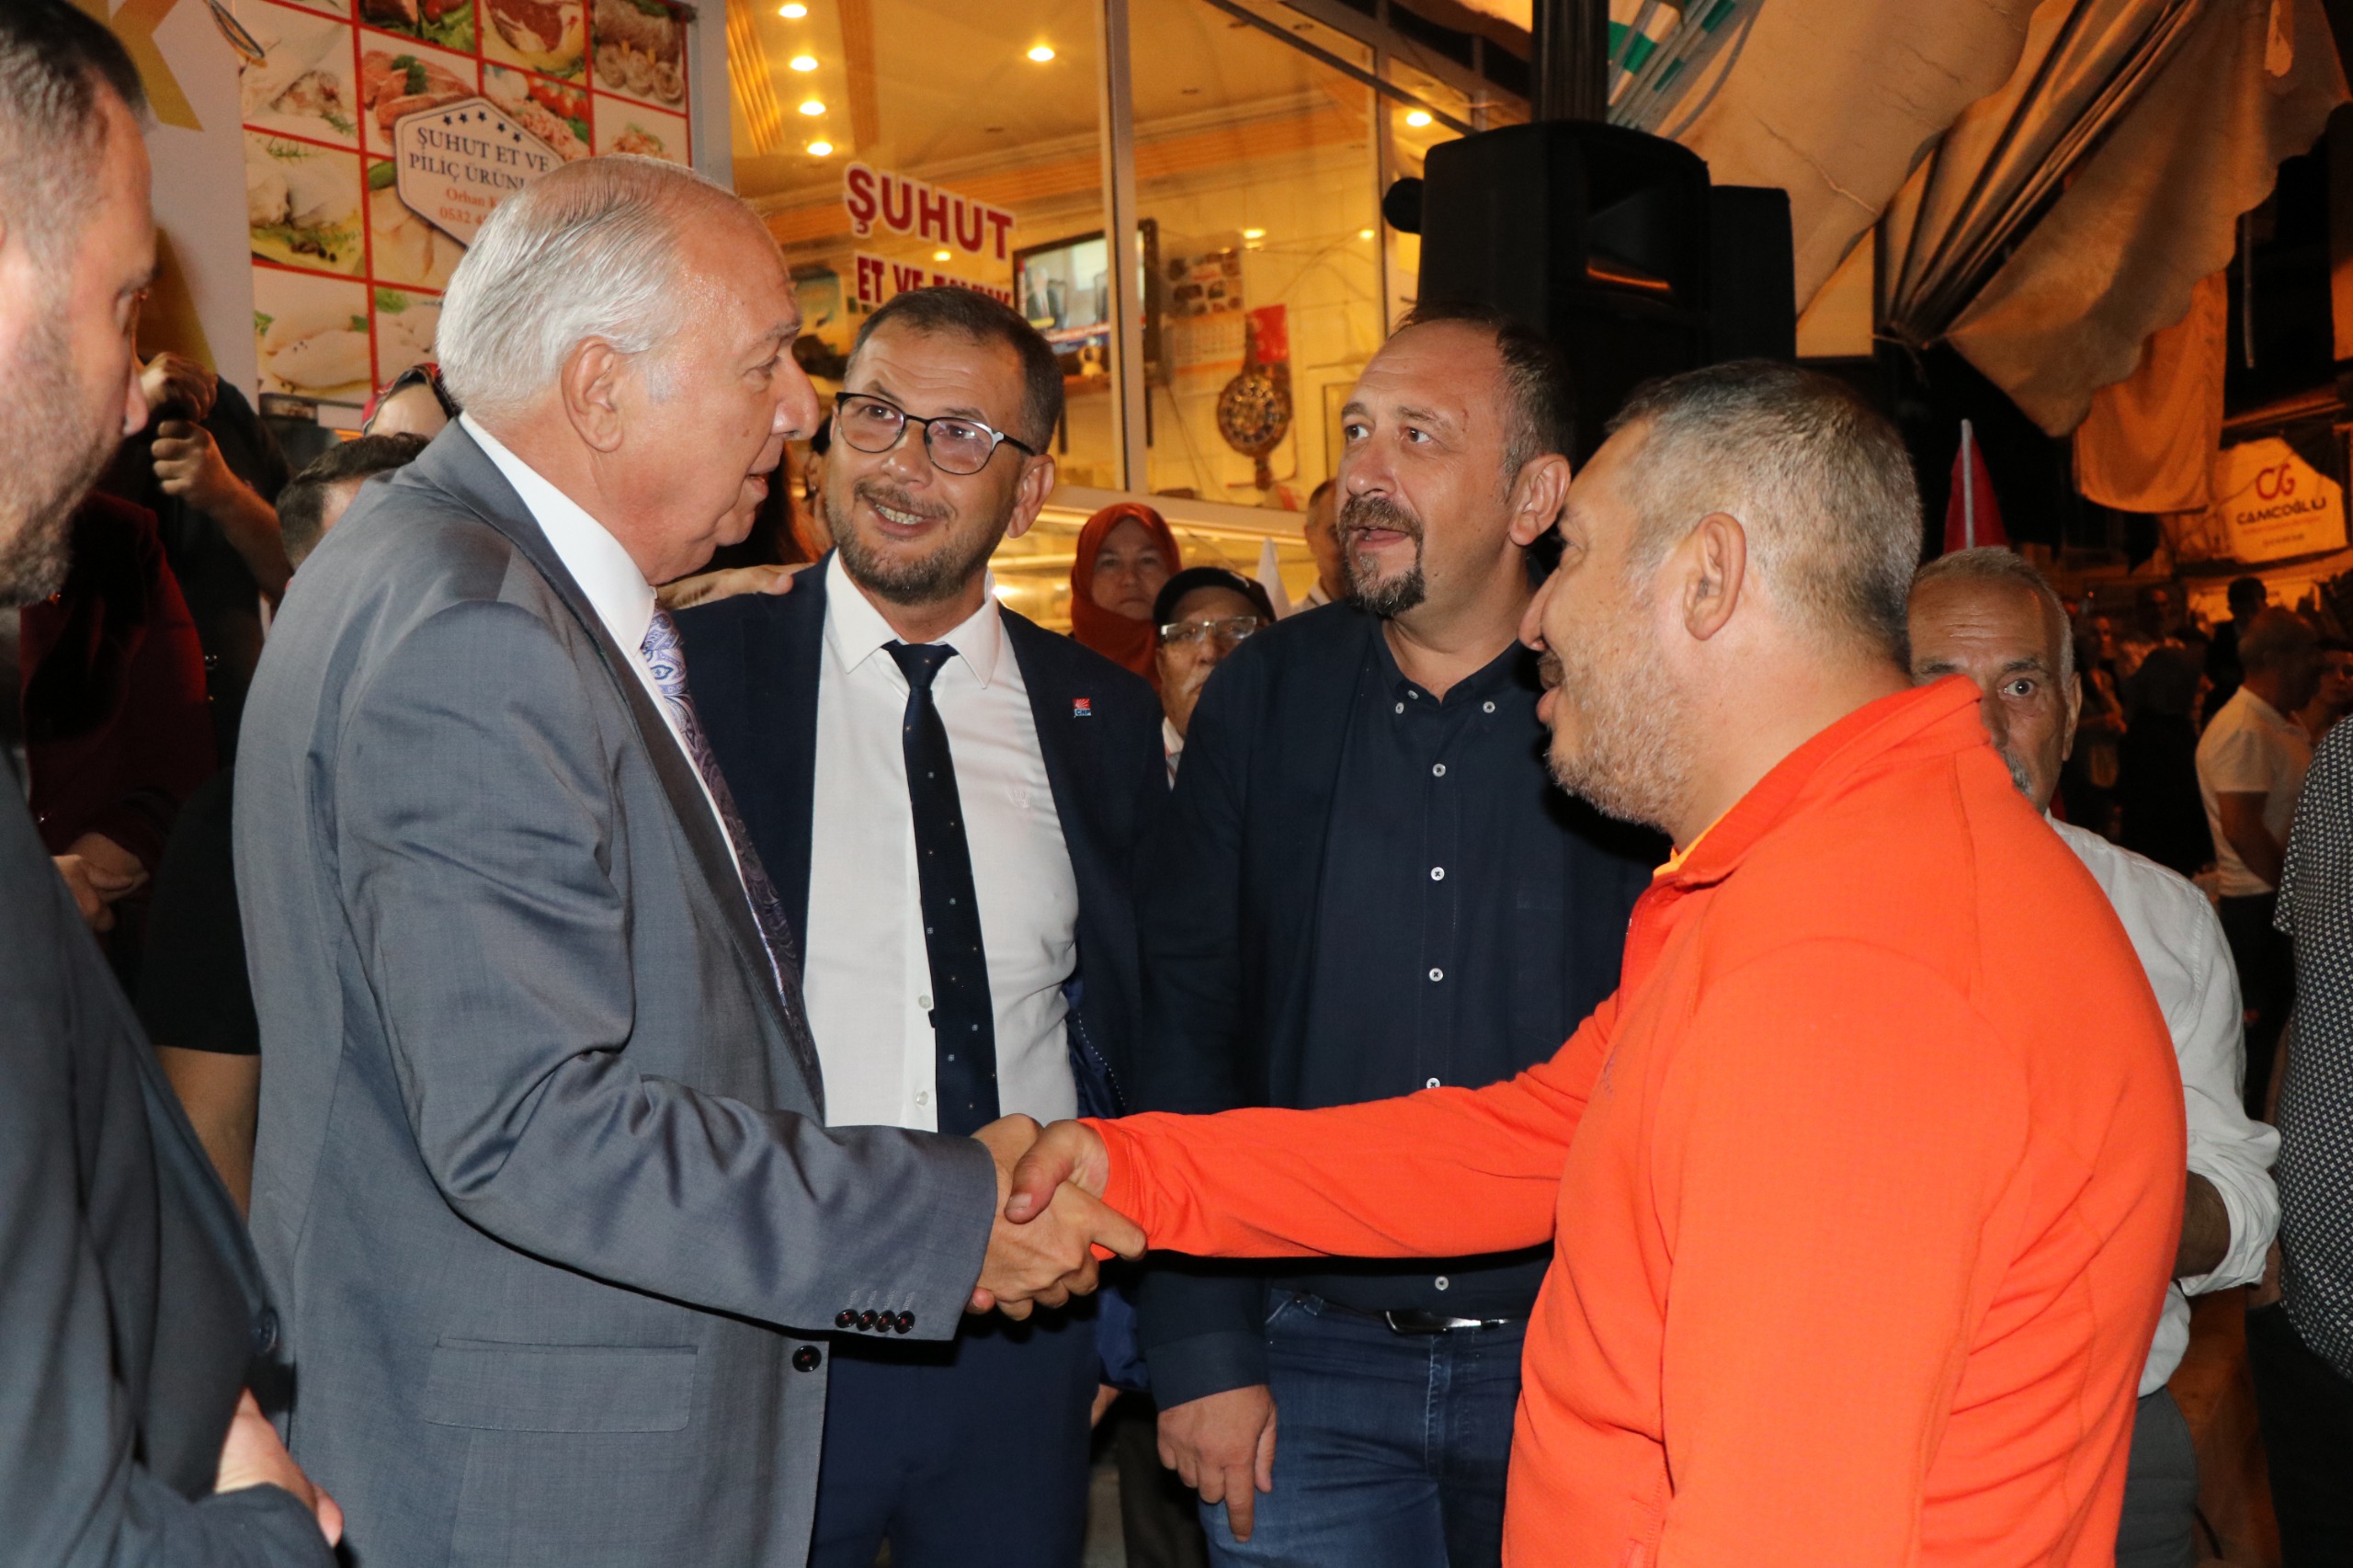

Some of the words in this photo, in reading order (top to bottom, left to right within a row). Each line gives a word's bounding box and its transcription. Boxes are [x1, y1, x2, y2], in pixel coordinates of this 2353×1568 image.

[409, 152, 460, 182] PİLİÇ
[417, 127, 490, 158] ŞUHUT
[496, 145, 521, 165] ET
[525, 152, 550, 172] VE
[446, 188, 485, 207] Orhan
[847, 168, 1014, 260] ŞUHUT
[858, 256, 884, 303] ET
